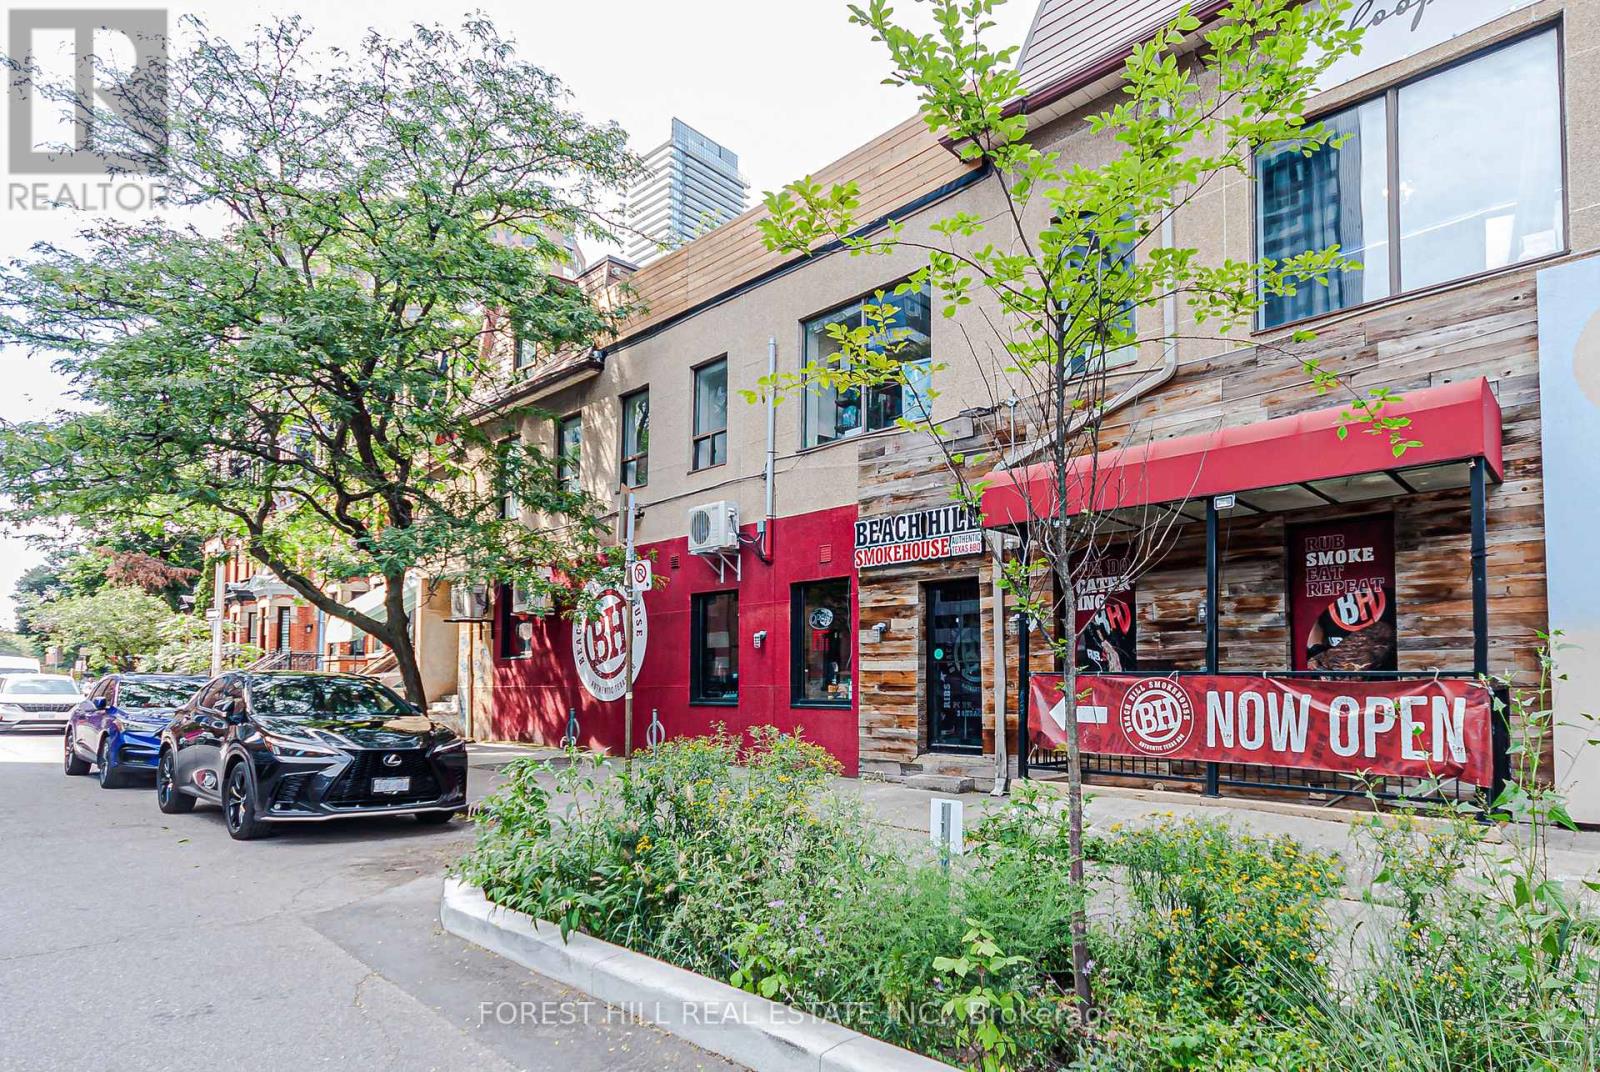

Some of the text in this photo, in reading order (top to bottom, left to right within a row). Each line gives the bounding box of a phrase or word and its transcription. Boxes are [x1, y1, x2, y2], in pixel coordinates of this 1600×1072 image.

[855, 502, 979, 547] BEACH HILL
[855, 538, 950, 567] SMOKEHOUSE
[952, 543, 968, 555] TEXAS
[1305, 535, 1344, 552] RUB
[1305, 547, 1375, 567] SMOKE
[1306, 565, 1344, 581] EAT
[1306, 577, 1385, 598] REPEAT
[1077, 593, 1106, 611] ING
[1123, 681, 1191, 734] BEACH HILL SMOKEHOUSE
[1137, 698, 1179, 735] BH
[1206, 691, 1467, 763] NOW OPEN
